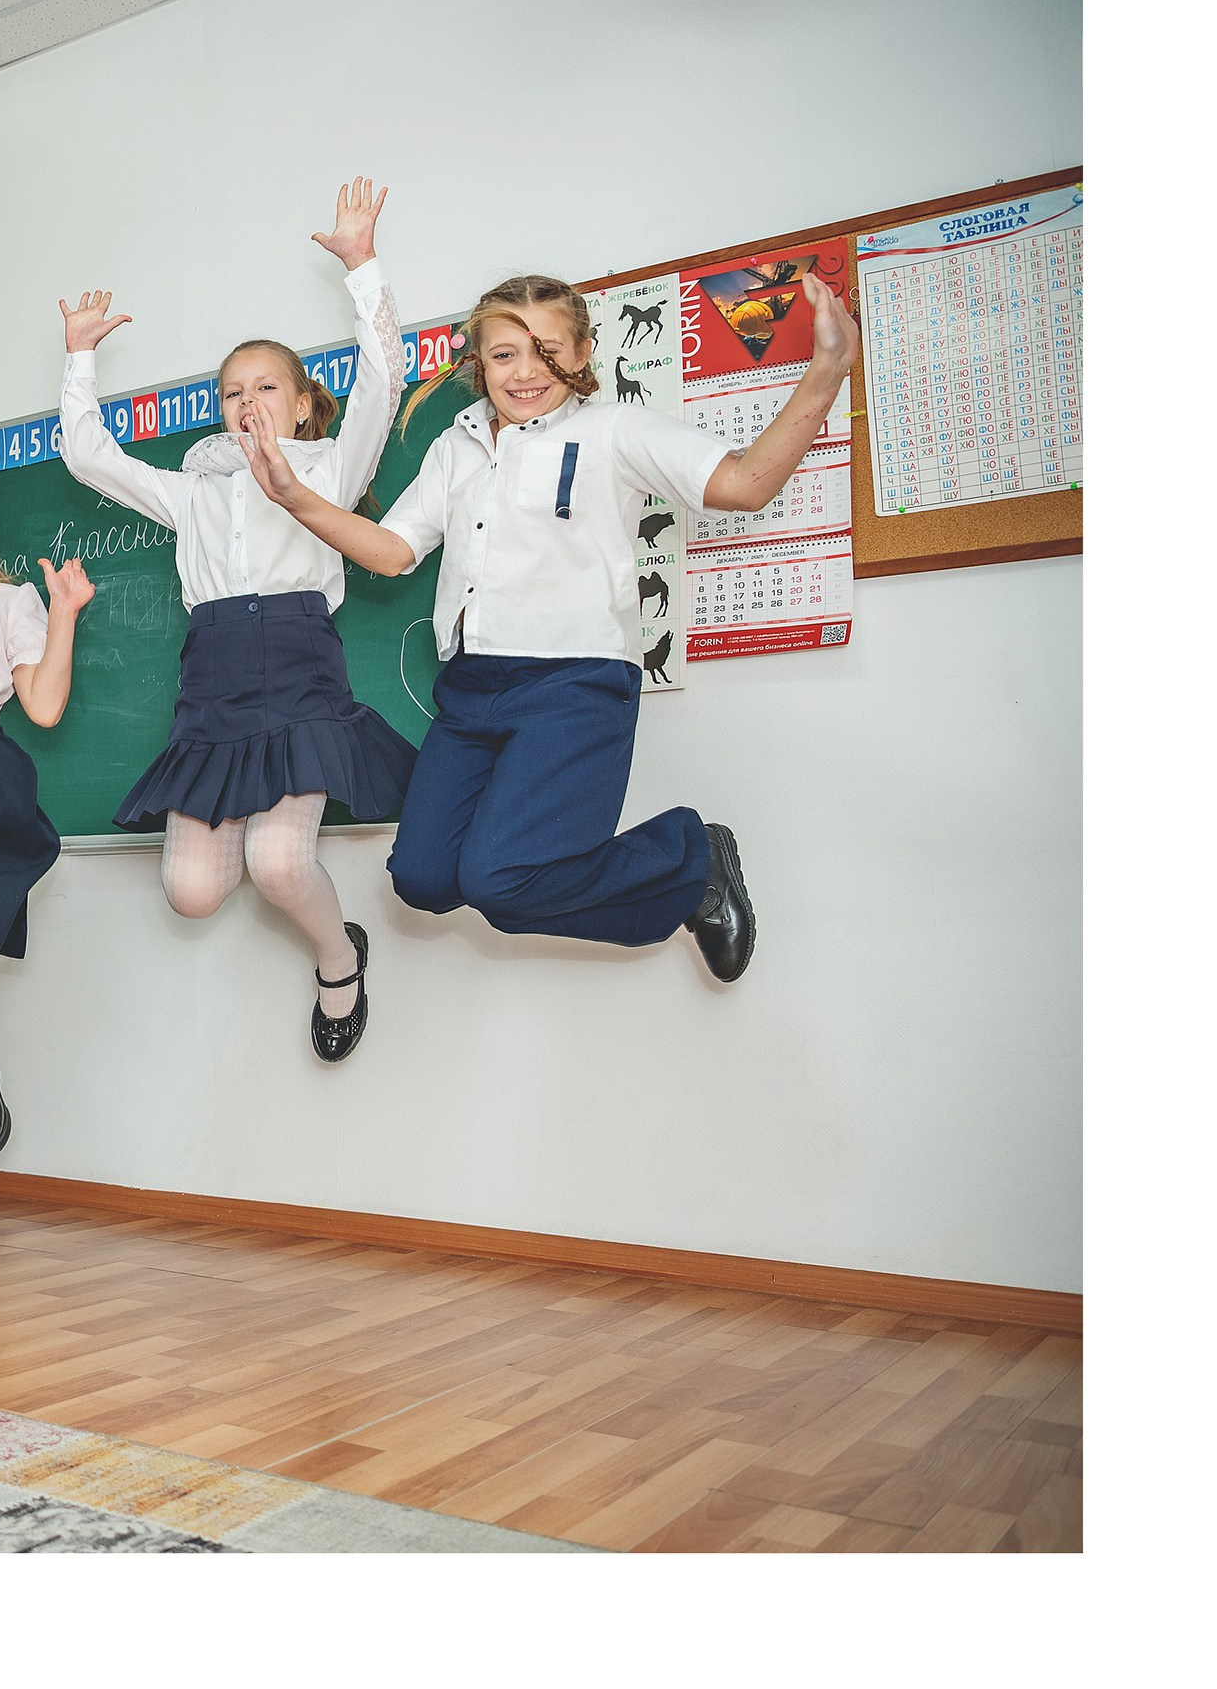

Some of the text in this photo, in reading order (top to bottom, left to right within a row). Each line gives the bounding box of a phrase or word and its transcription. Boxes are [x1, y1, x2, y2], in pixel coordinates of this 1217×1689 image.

[939, 202, 1030, 232] СЛОГОВАЯ
[943, 216, 1028, 243] ТАБЛИЦА
[912, 266, 916, 274] Я
[949, 257, 957, 265] Ю
[1011, 243, 1017, 251] Э
[1032, 239, 1037, 247] Е
[1052, 233, 1060, 242] Ы
[874, 285, 879, 293] Б
[910, 277, 920, 285] БЯ
[929, 273, 940, 281] БУ
[947, 267, 961, 277] БЮ
[968, 263, 980, 272] БО
[1009, 254, 1020, 263] БЭ
[1030, 249, 1041, 258] БЕ
[1050, 245, 1063, 255] БЫ
[607, 282, 669, 303] ЖЕРЕБЁНОК
[681, 279, 702, 373] FORIN
[627, 356, 673, 373] ЖИРАФ
[770, 371, 803, 380] NOVEMBER
[9, 433, 21, 461] 4
[29, 429, 41, 458] 5
[50, 423, 61, 452] 6
[115, 408, 128, 438] 9
[136, 399, 156, 434] 10
[161, 395, 182, 429] 11
[187, 388, 210, 422] 12
[329, 355, 353, 391] 17
[421, 334, 450, 372] 20
[902, 451, 914, 459] ХА
[922, 447, 933, 456] ХЯ
[941, 444, 953, 453] ХУ
[960, 440, 974, 449] ХЮ
[982, 437, 994, 446] ХО
[1022, 429, 1035, 438] ХЭ
[1044, 426, 1055, 435] ХЕ
[1064, 422, 1078, 431] ХЫ
[920, 435, 933, 444] ФЯ
[939, 432, 952, 441] ФУ
[958, 428, 974, 437] ФЮ
[979, 425, 994, 433] ФО
[1020, 417, 1034, 426] ФЭ
[1042, 413, 1055, 422] ФЕ
[1062, 410, 1078, 419] ФЫ
[886, 434, 1080, 474] Ц ЦА ЦУ ЦО ЦЕ ЦЫ
[887, 462, 1060, 497] Ш ША ШУ ШО ШЕ
[811, 495, 821, 503] 21
[753, 513, 764, 521] 25
[637, 554, 675, 568] БЛЮД
[694, 638, 723, 647] FORIN
